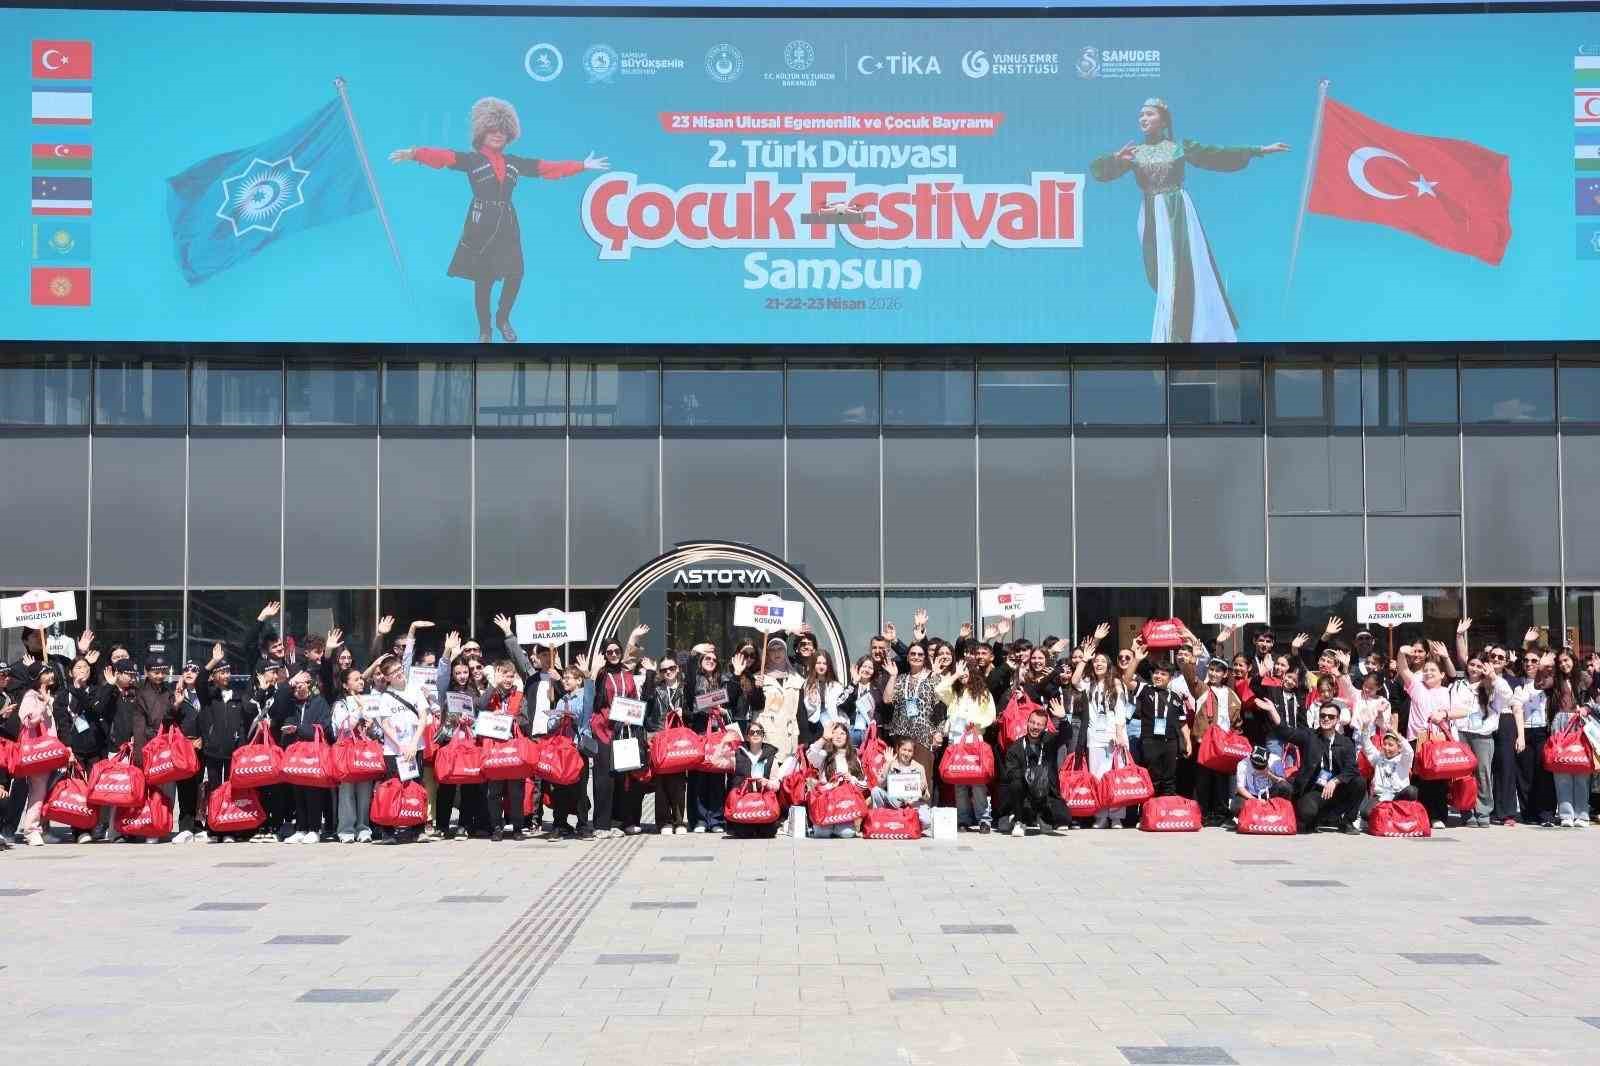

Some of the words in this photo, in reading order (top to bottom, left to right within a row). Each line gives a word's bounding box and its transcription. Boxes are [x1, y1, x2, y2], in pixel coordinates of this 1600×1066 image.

[886, 51, 942, 75] TİKA
[992, 54, 1028, 64] YUNUS
[1029, 54, 1059, 64] EMRE
[671, 116, 690, 128] 23
[692, 116, 734, 128] Nisan
[736, 116, 781, 128] Ulusal
[784, 116, 860, 130] Egemenlik
[864, 118, 882, 128] ve
[885, 115, 930, 130] Çocuk
[933, 116, 994, 130] Bayramı
[708, 140, 737, 168] 2.
[741, 140, 818, 168] Türk
[822, 140, 957, 169] Dünyası
[586, 176, 798, 255] Çocuk
[808, 176, 1079, 242] Festivali
[743, 251, 922, 290] Samsun
[765, 298, 825, 310] 21-22-23
[827, 298, 864, 310] Nisan
[869, 298, 902, 310] 2026
[673, 569, 771, 584] ASTORYA
[754, 616, 783, 625] KOSOVA
[1368, 612, 1412, 620] AZERBAYCAN
